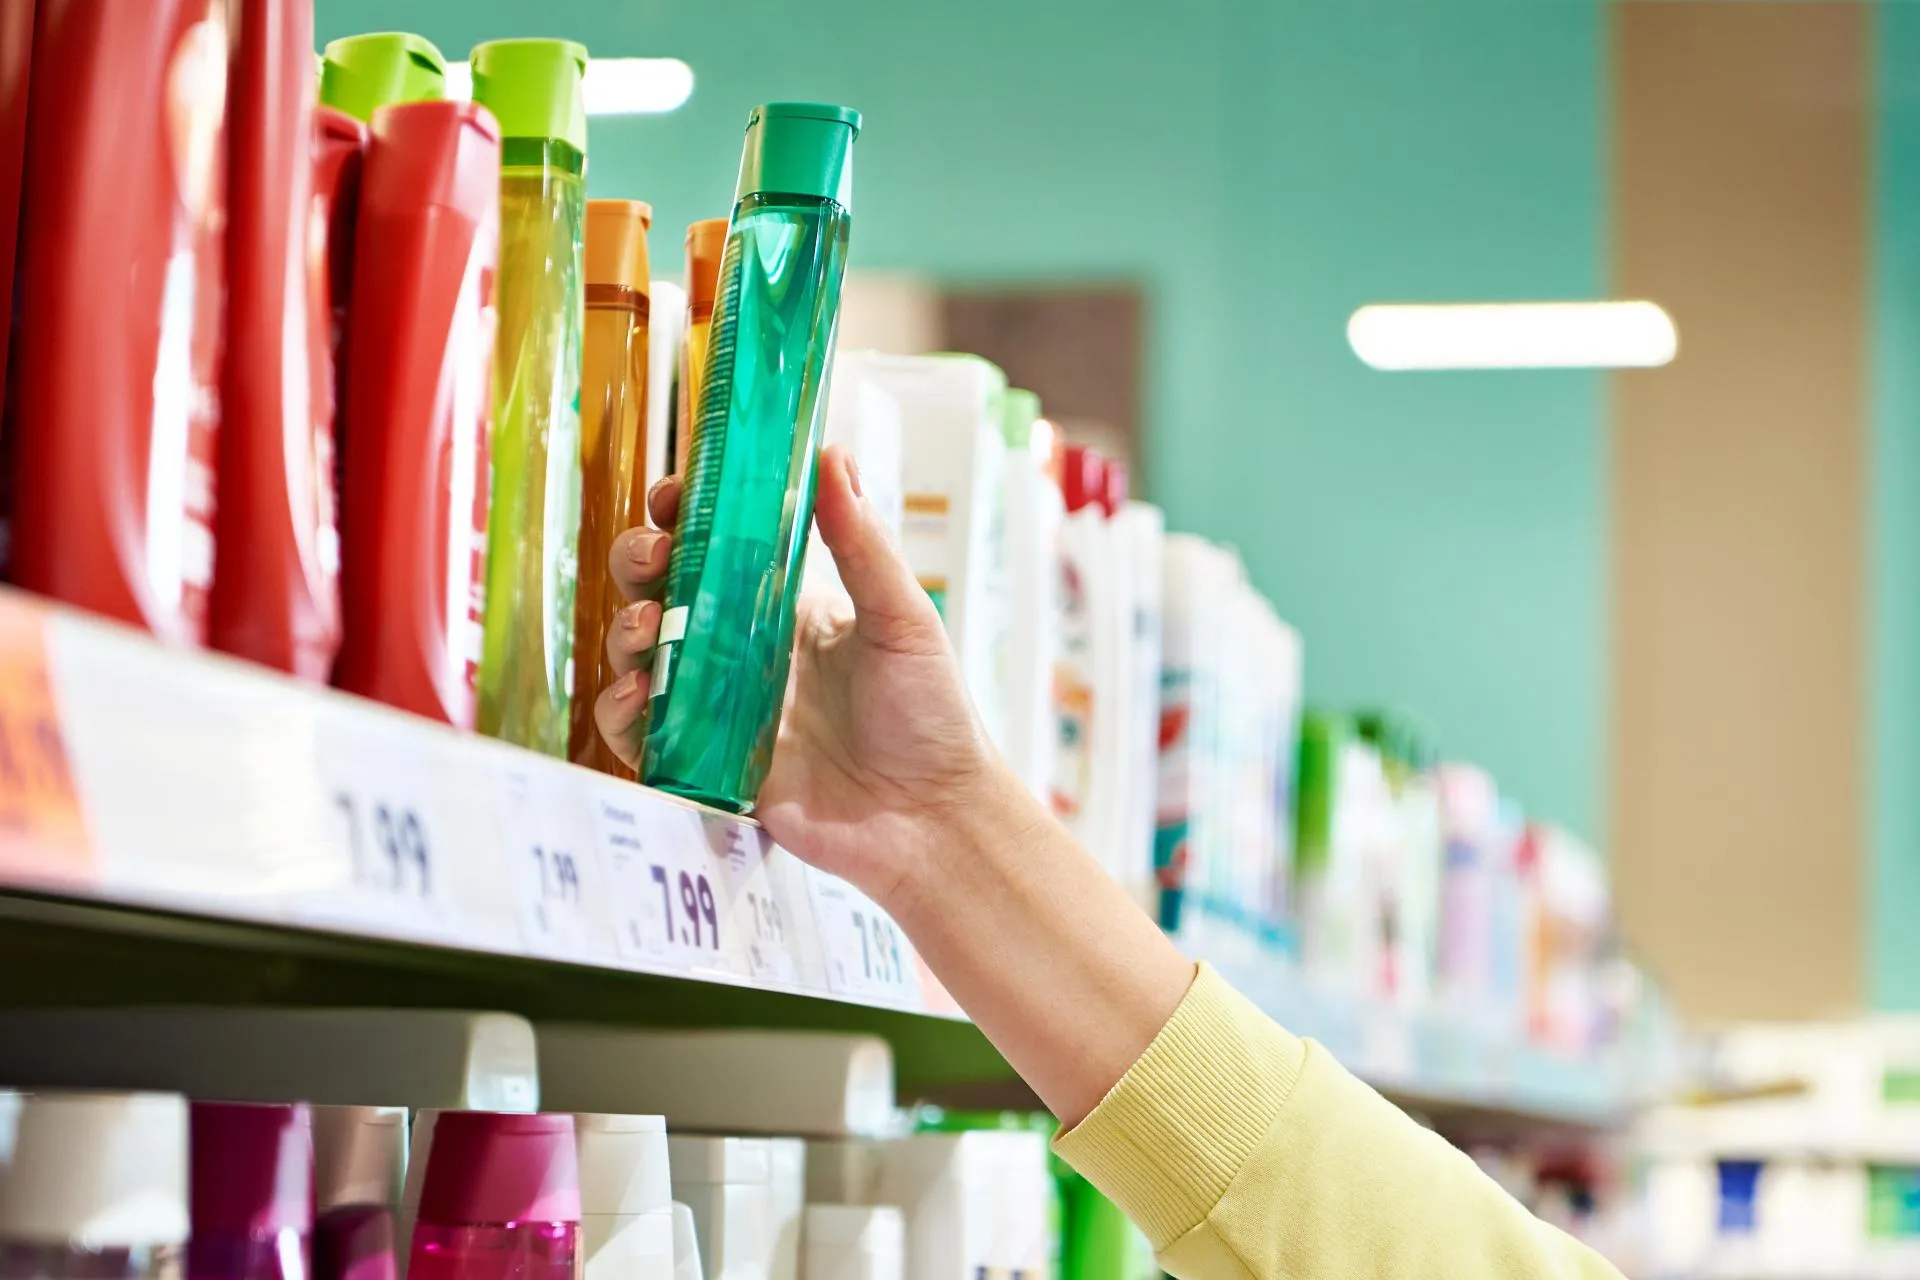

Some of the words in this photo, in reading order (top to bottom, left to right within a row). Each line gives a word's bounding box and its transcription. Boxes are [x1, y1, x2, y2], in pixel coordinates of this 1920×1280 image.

[332, 790, 431, 897] 7.99
[532, 846, 579, 903] 7.99
[650, 864, 719, 950] 7.99
[747, 892, 784, 944] 7.99
[852, 911, 902, 984] 7.99
